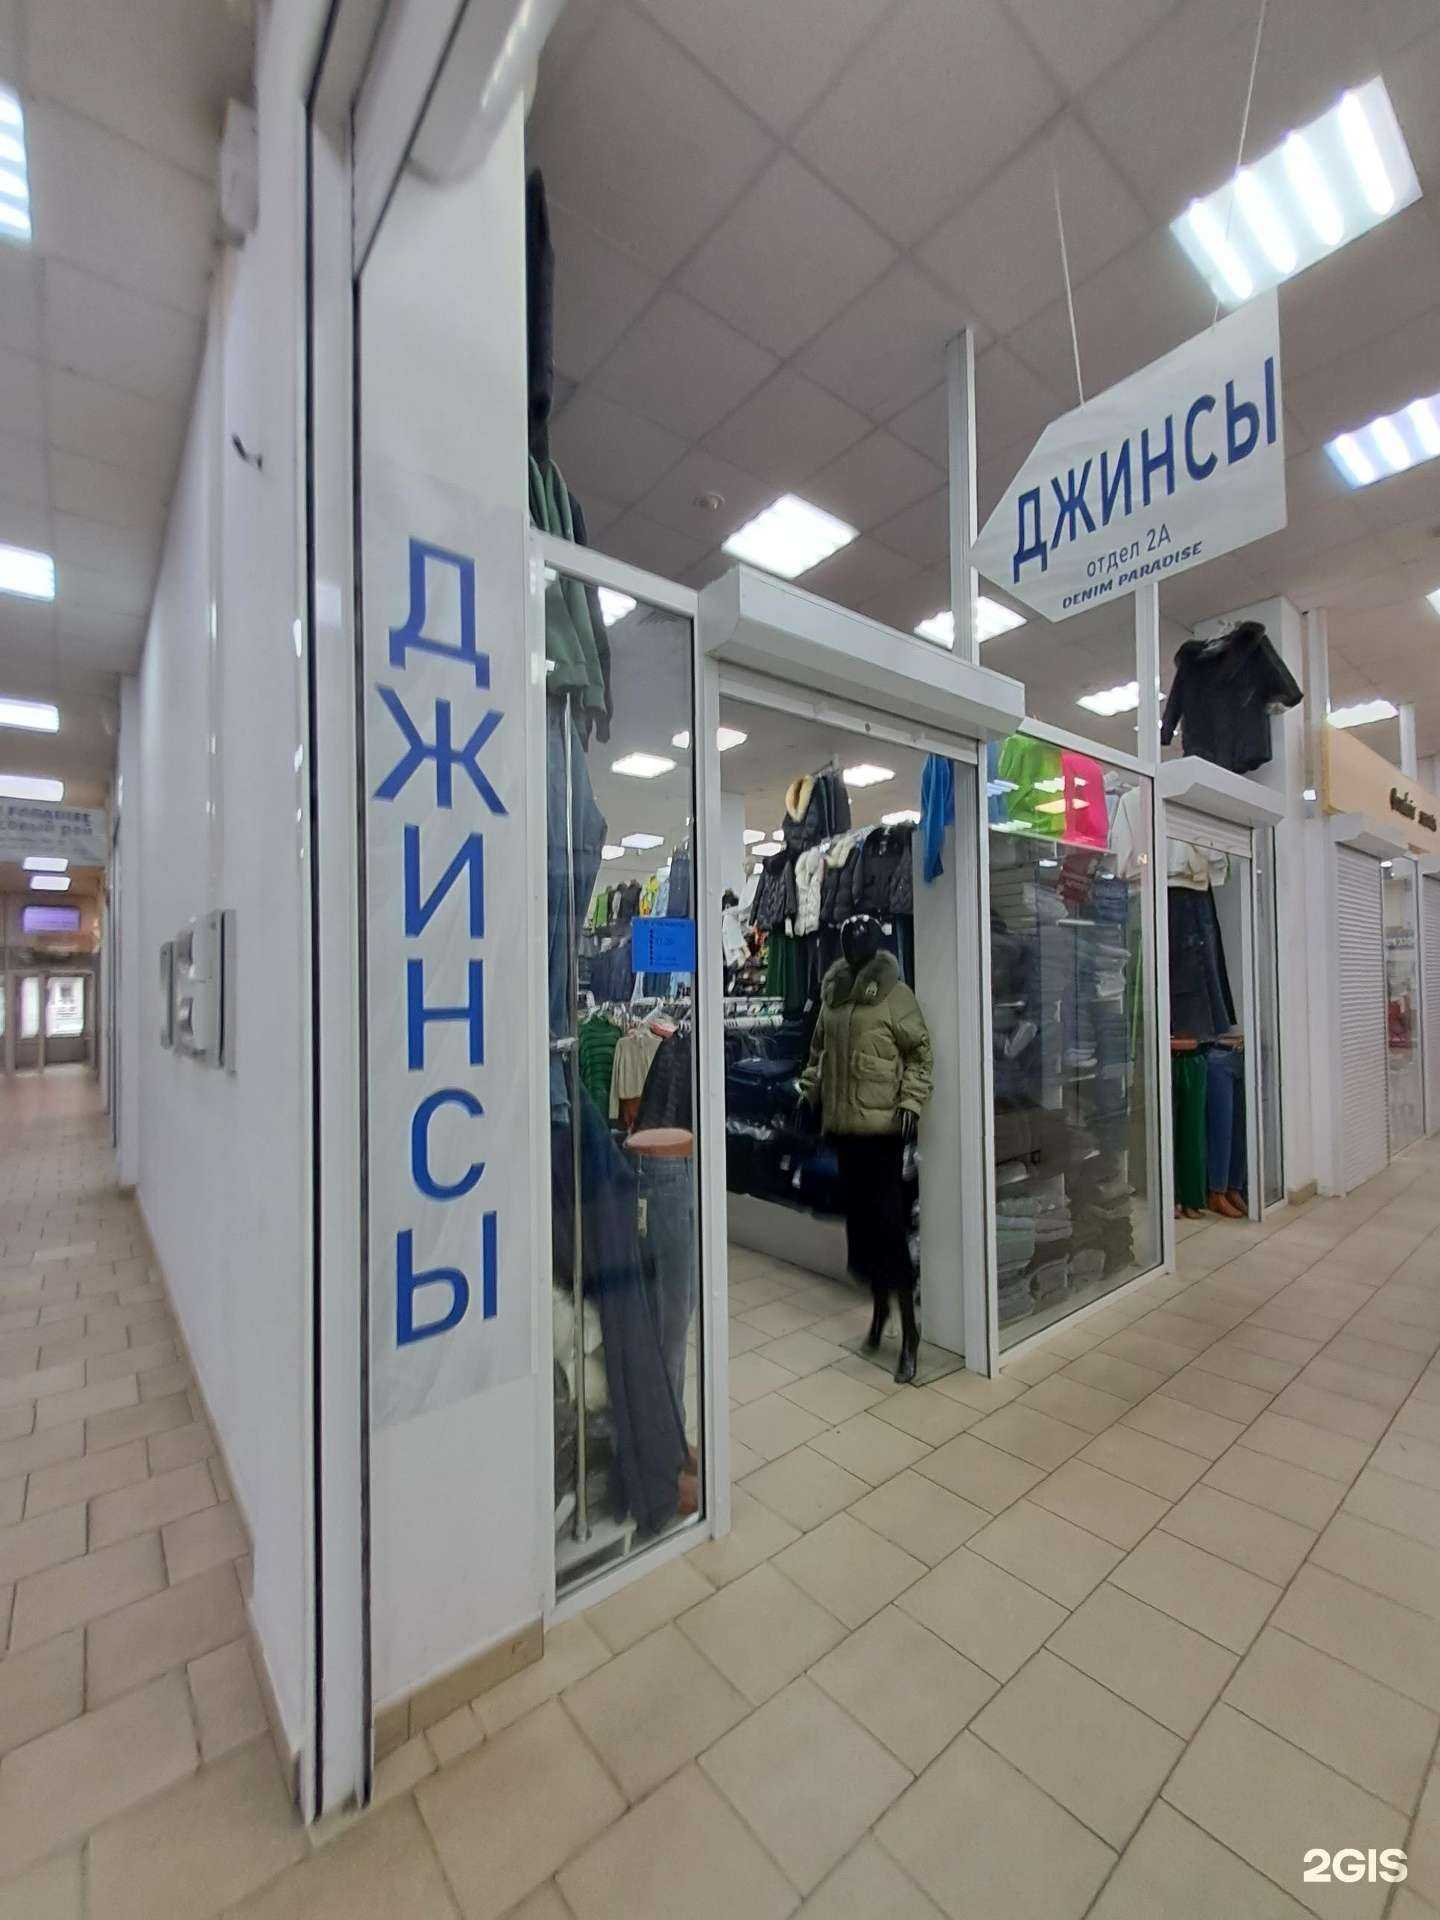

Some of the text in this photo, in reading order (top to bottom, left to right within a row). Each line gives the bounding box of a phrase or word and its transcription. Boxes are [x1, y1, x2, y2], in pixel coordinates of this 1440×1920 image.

[1013, 357, 1277, 583] ДЖИНСЫ
[1062, 540, 1203, 610] DENIM PARADISE
[1086, 541, 1140, 578] отдел
[374, 536, 507, 1347] ДЖИНСЫ
